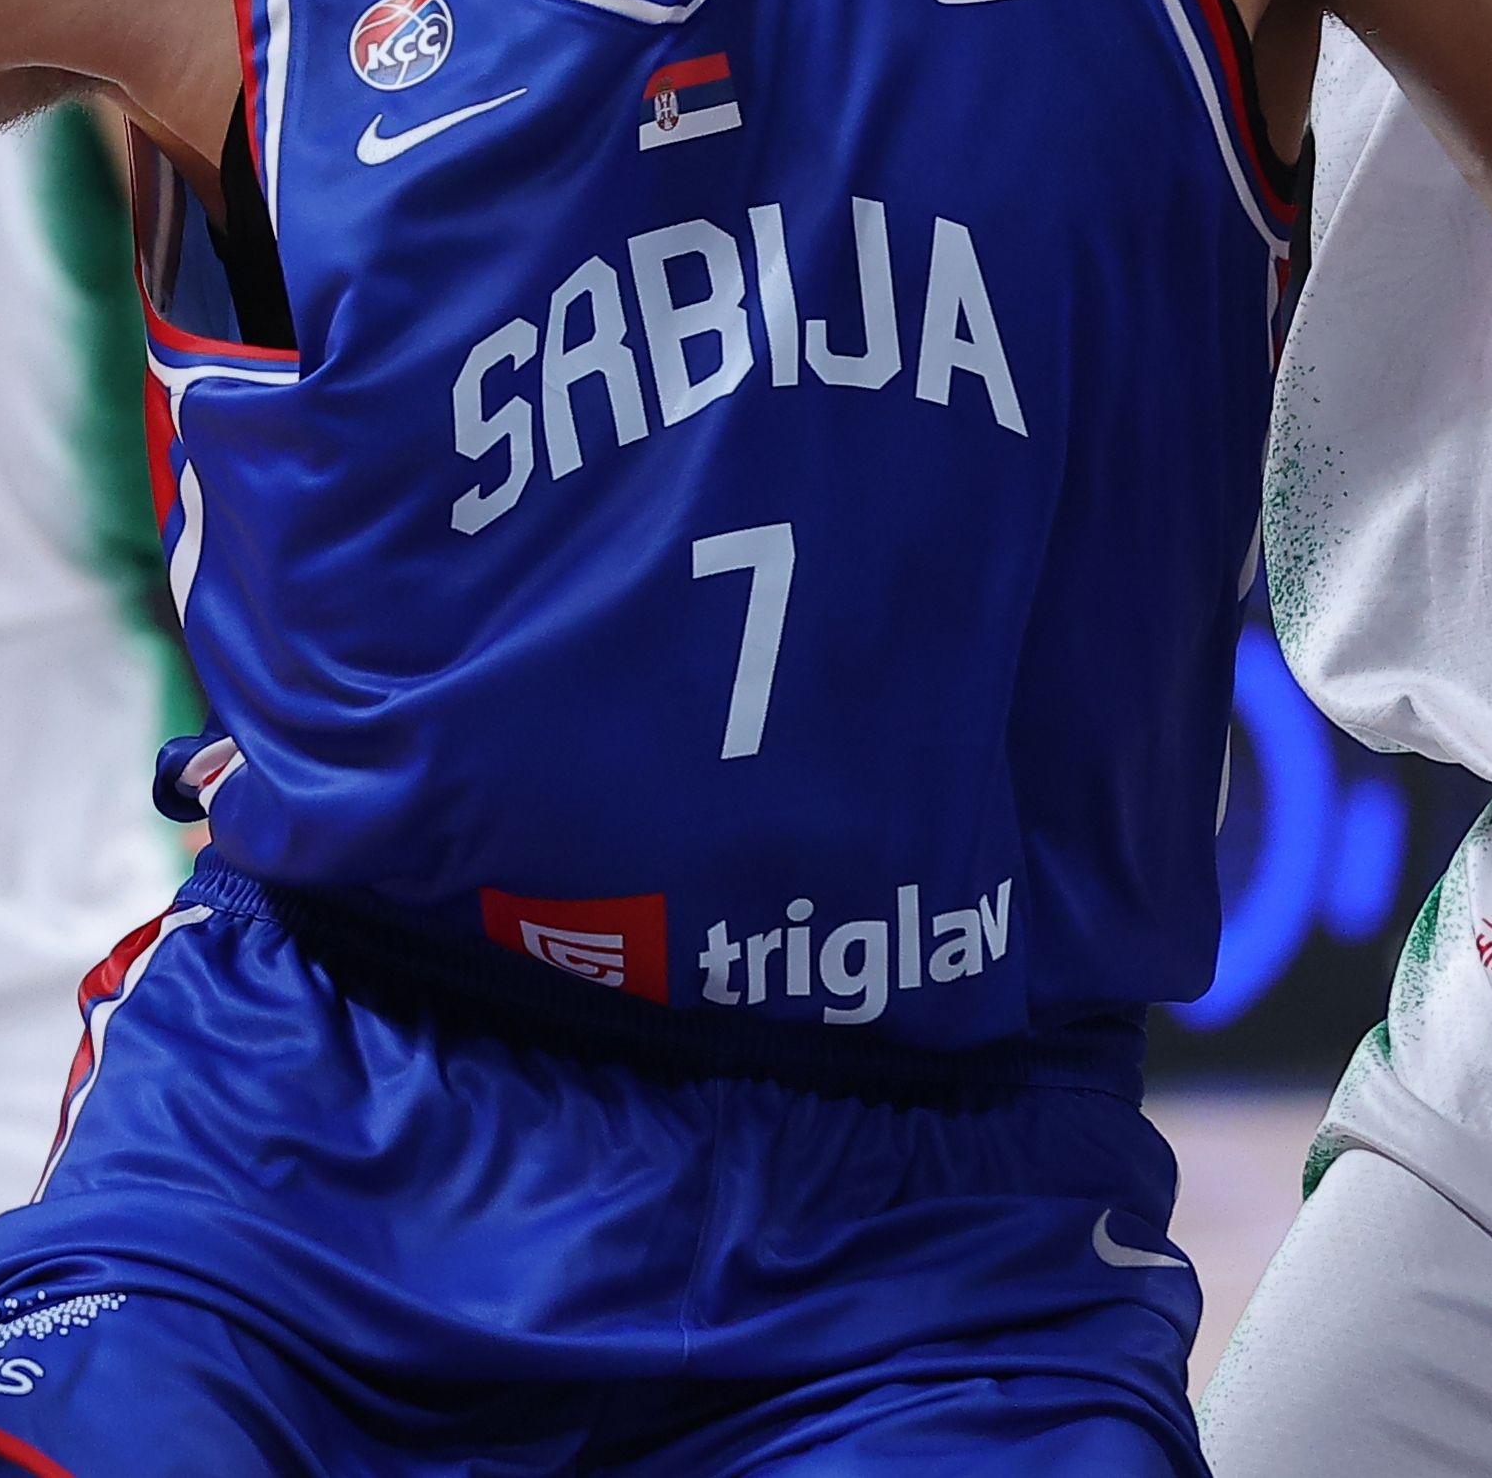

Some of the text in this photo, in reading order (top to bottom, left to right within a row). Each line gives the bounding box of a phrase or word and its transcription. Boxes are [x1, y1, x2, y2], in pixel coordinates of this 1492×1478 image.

[450, 195, 1029, 535] SRBIJA
[692, 522, 796, 760] 7
[699, 878, 1012, 1025] triglav
